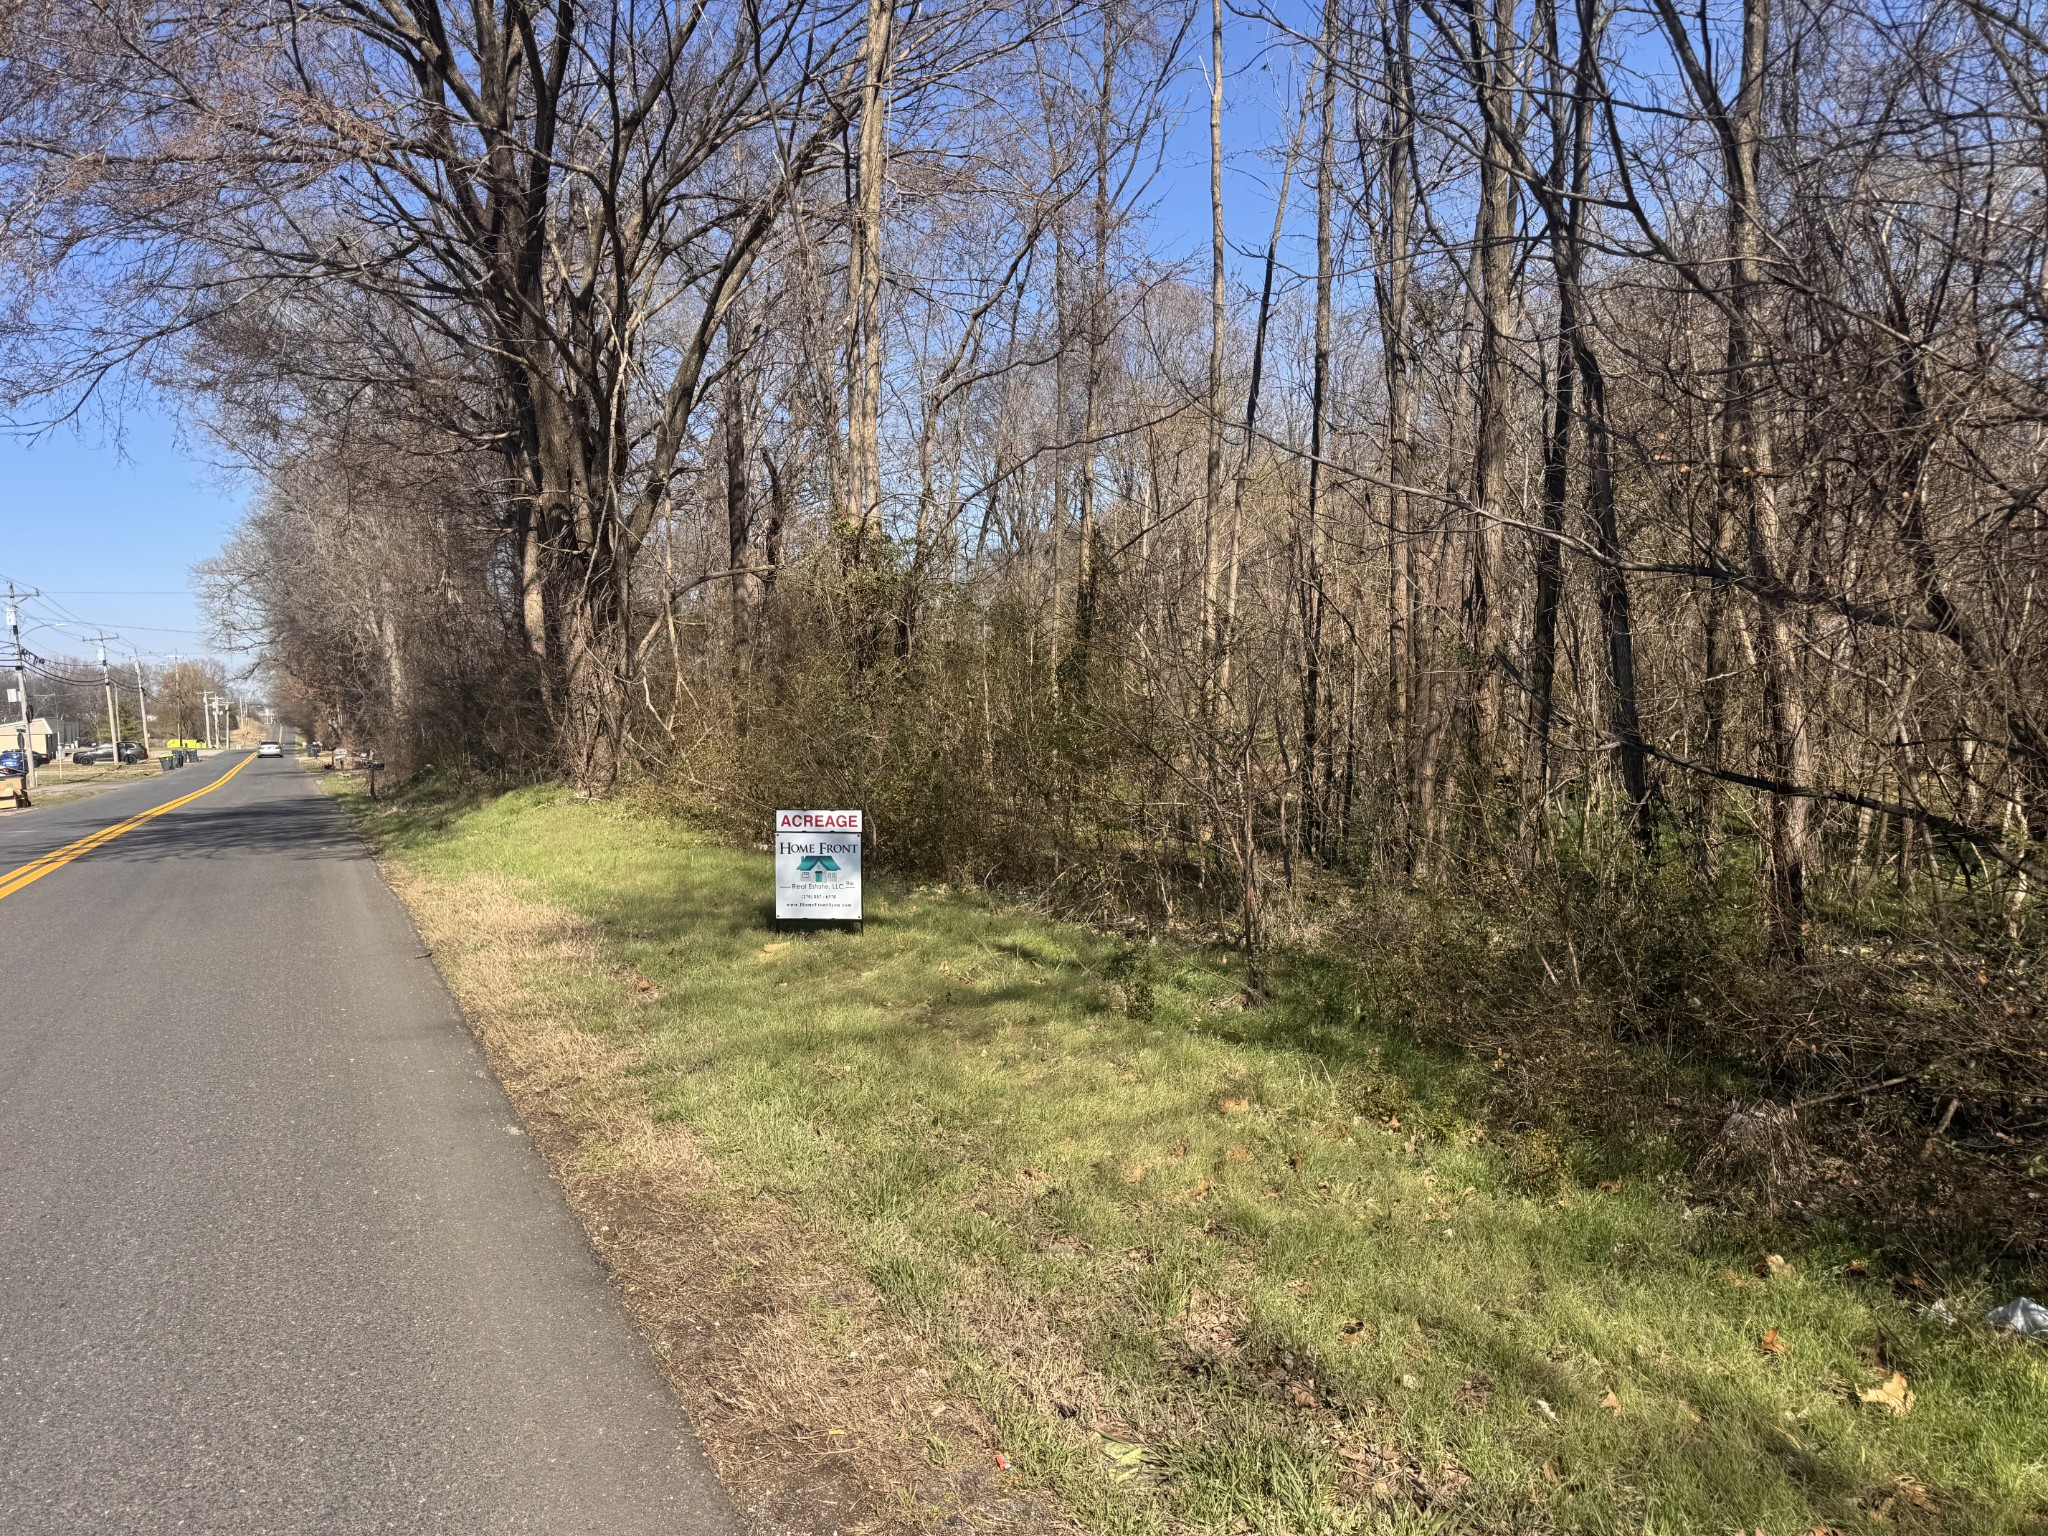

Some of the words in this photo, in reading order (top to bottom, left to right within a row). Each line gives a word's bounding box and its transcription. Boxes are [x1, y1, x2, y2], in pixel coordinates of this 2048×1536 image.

[781, 814, 858, 828] ACREAGE
[780, 842, 815, 855] HOME
[819, 842, 859, 855] FRONT
